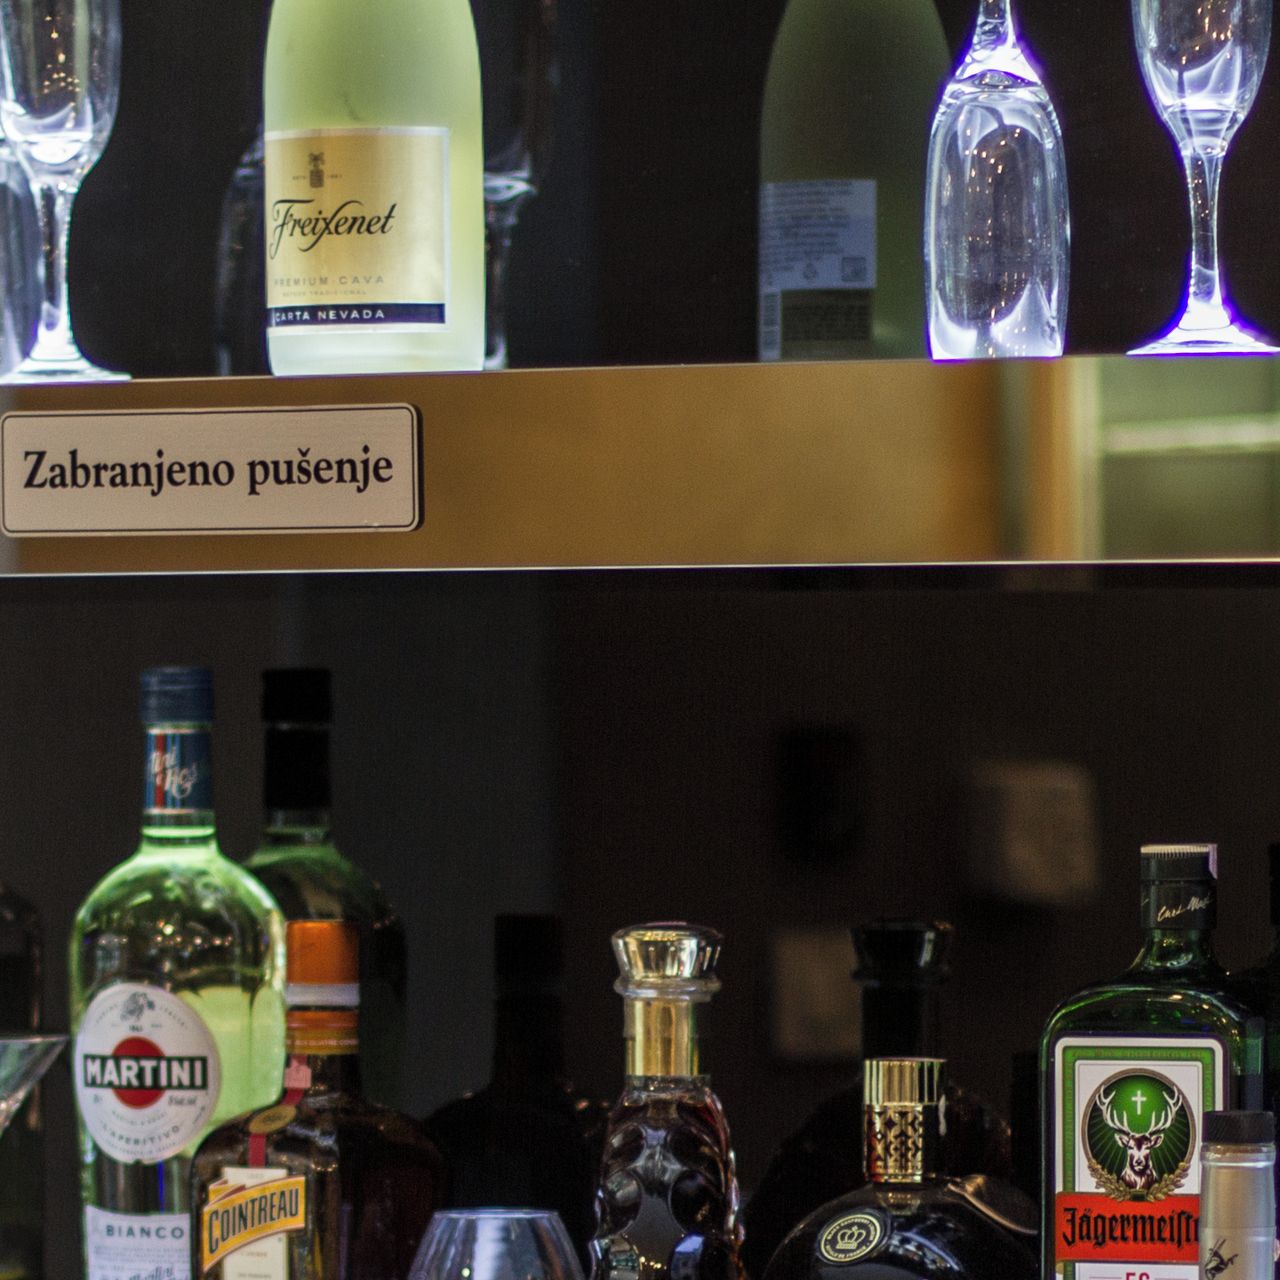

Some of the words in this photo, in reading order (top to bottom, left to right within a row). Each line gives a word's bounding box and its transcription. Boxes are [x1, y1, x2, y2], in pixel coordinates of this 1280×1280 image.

[270, 199, 397, 260] Freixenet
[339, 275, 384, 285] CAVA
[275, 309, 310, 322] CARTA
[318, 309, 385, 320] NEVADA
[23, 448, 235, 497] Zabranjeno
[247, 444, 393, 496] pušenje
[86, 1057, 203, 1087] MARTINI
[106, 1224, 184, 1239] BIANCO
[208, 1188, 299, 1254] COINTREAU
